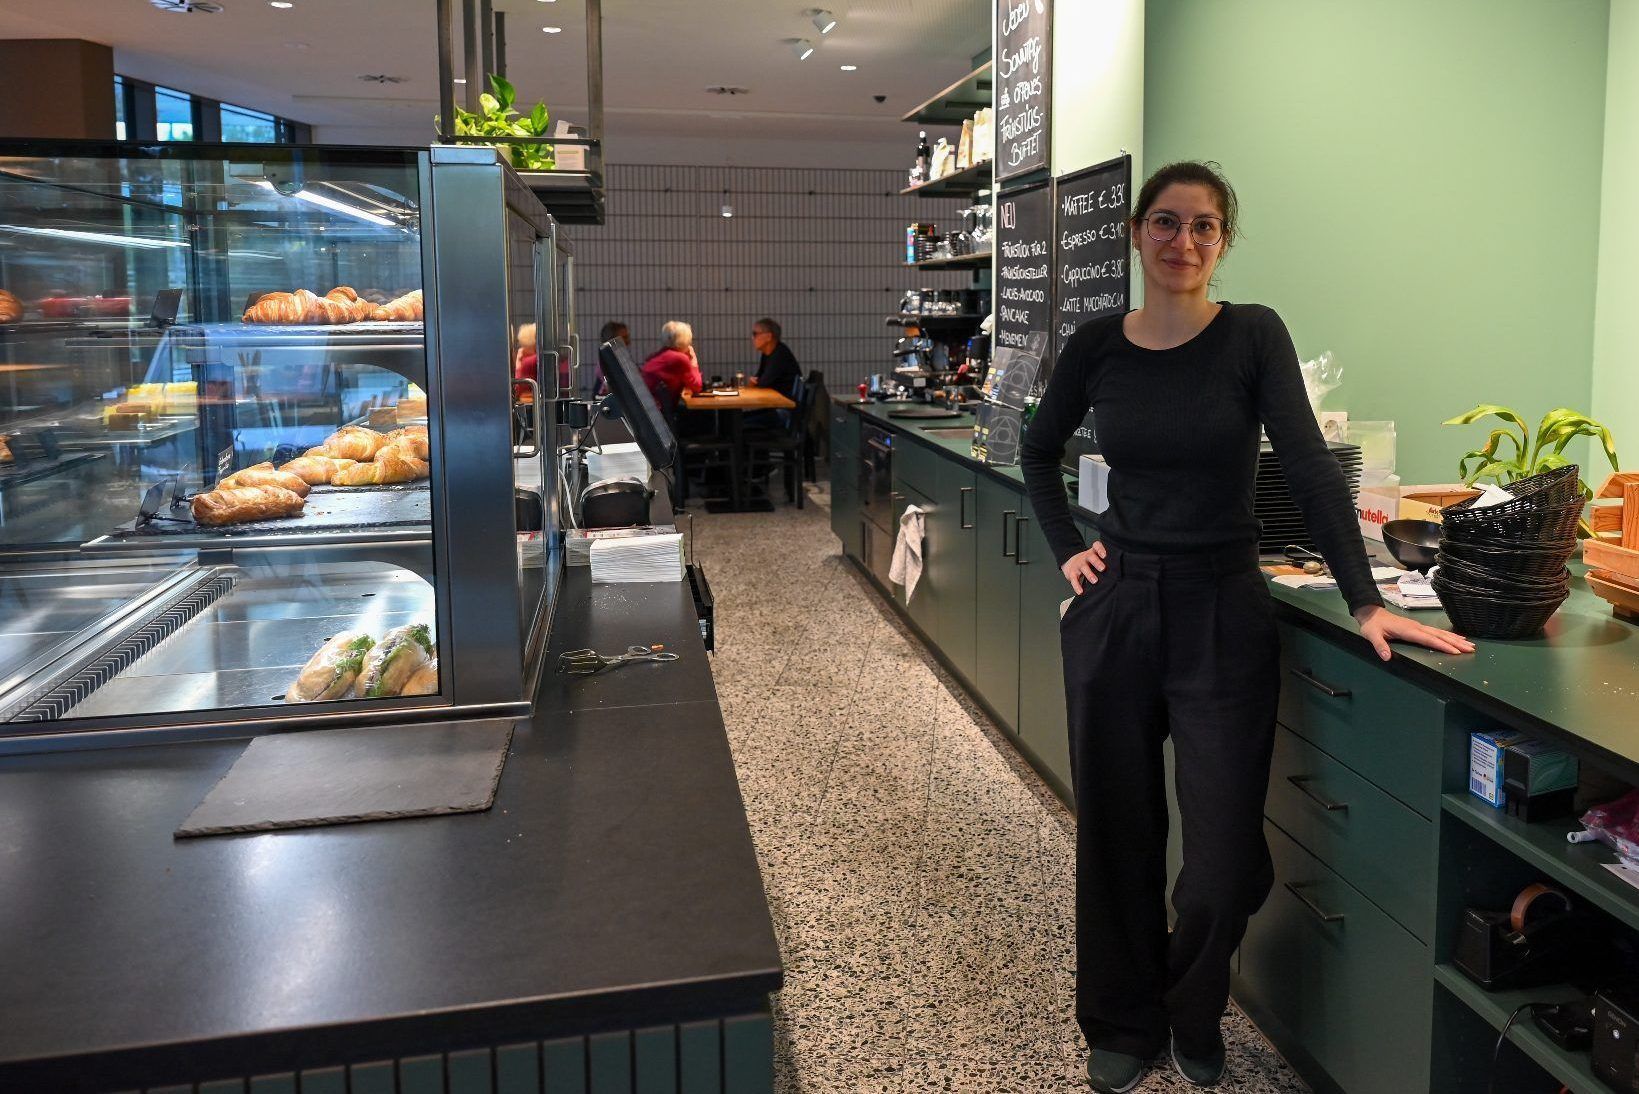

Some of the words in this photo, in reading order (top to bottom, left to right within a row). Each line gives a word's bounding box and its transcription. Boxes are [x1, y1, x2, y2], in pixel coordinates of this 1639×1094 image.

[1008, 130, 1042, 167] BUFFET
[1064, 191, 1095, 216] KAFFEE
[1000, 201, 1016, 230] NEU
[1041, 240, 1048, 255] 2
[1062, 230, 1097, 250] ESPRESSO
[1063, 262, 1101, 288] CAPPUCCINO
[1001, 304, 1030, 325] PANCAKE
[1062, 297, 1081, 313] LATTE
[1357, 508, 1389, 525] nutella
